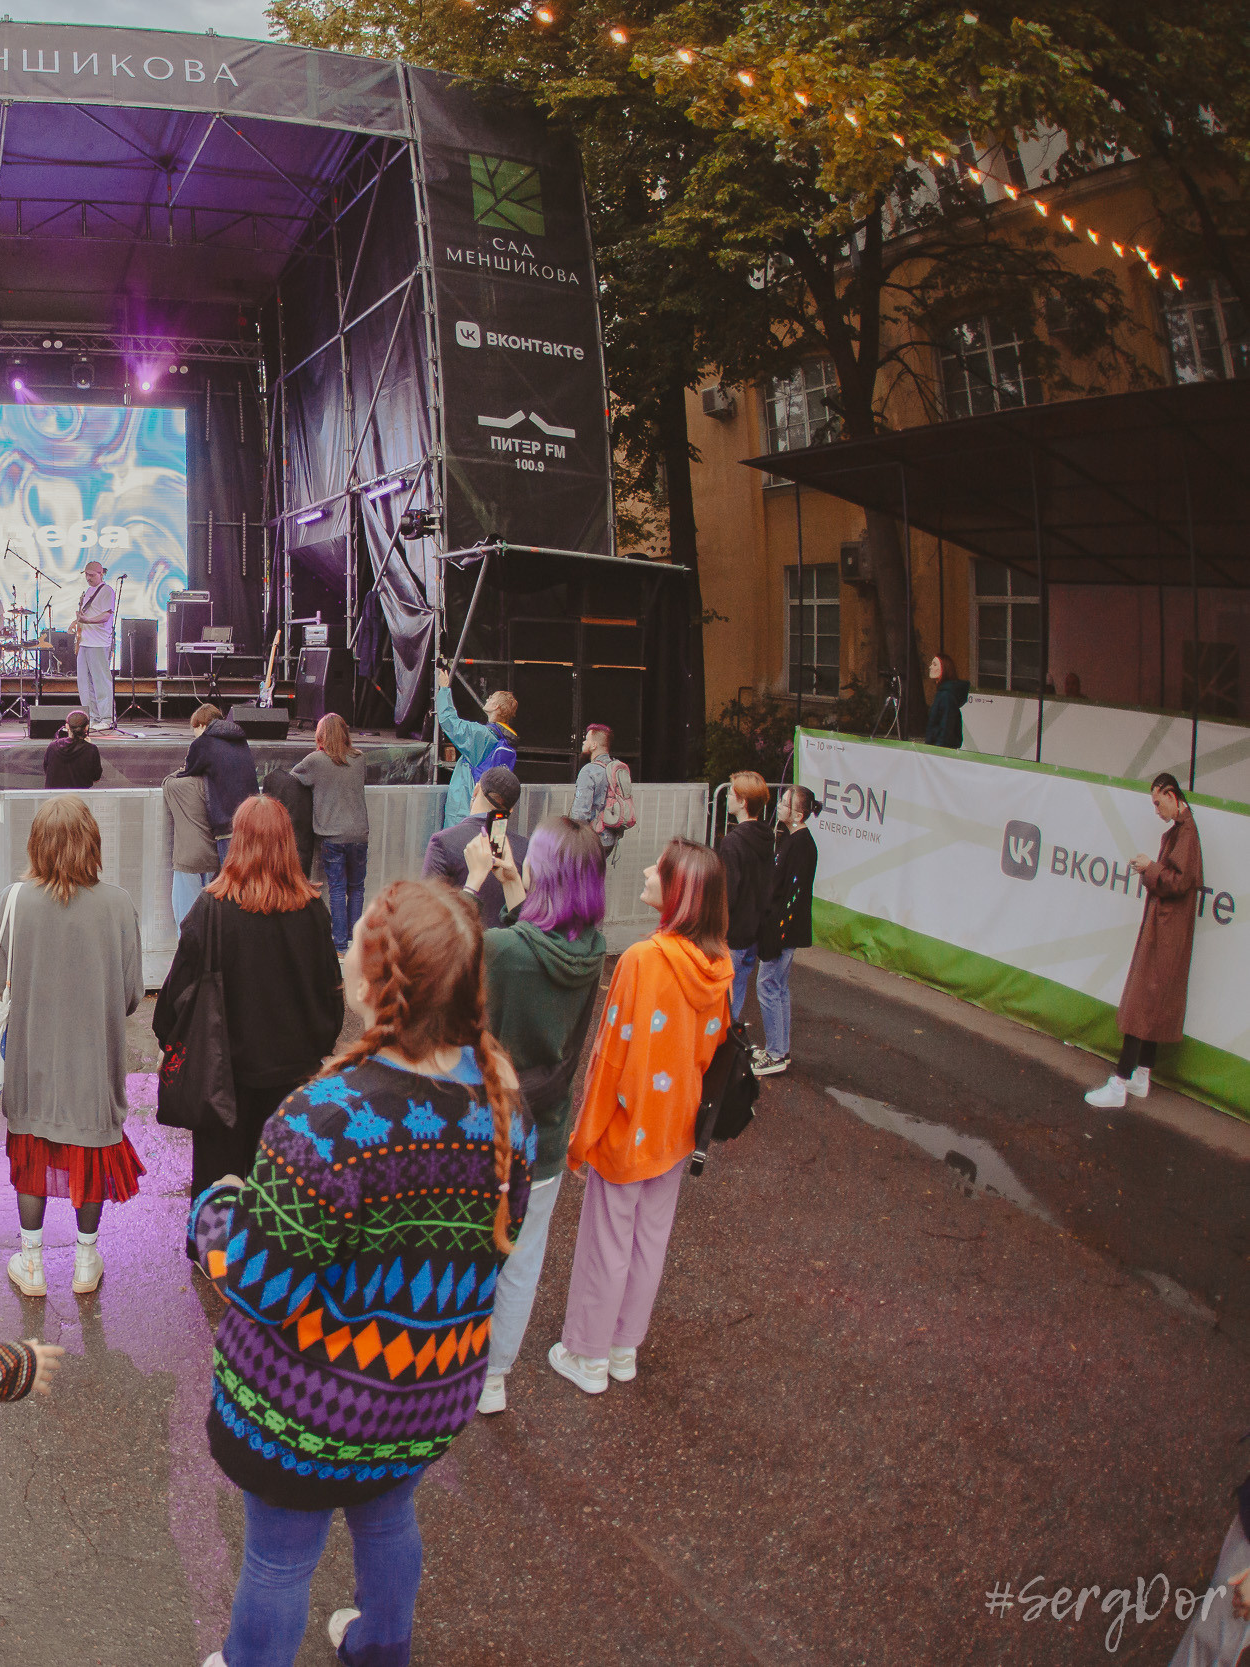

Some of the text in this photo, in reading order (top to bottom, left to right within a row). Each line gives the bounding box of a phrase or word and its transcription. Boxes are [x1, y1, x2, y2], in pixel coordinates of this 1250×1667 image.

[492, 237, 535, 259] САД
[446, 247, 580, 285] МЕНШИКОВА
[545, 443, 566, 459] FM
[515, 458, 546, 472] 100.9
[818, 820, 882, 845] ENERGY DRINK
